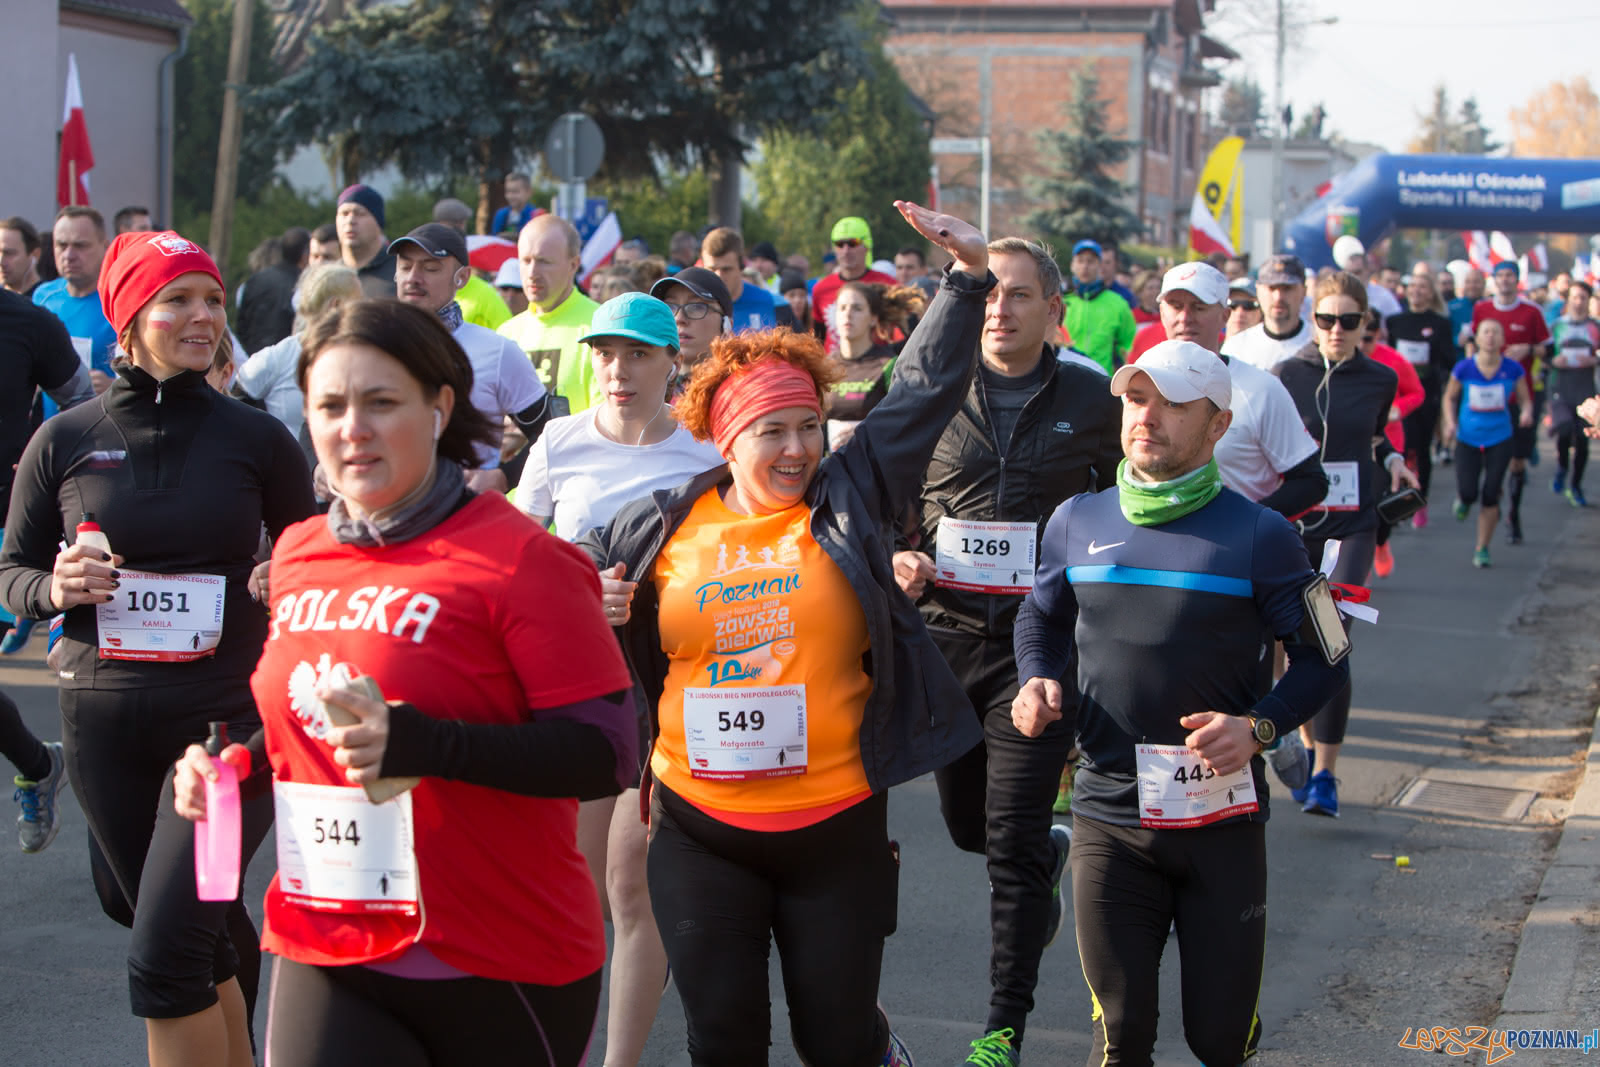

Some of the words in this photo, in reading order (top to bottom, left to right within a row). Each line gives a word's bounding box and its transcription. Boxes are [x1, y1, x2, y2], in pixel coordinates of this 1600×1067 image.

[961, 537, 1010, 556] 1269
[973, 561, 996, 569] Szymon
[144, 573, 160, 581] BIEG
[161, 574, 220, 585] NIEPODLEGŁOŚCI
[695, 568, 803, 613] Poznań
[127, 590, 190, 613] 1051
[214, 600, 222, 623] STREFA
[270, 584, 440, 643] POLSKA
[714, 606, 789, 637] zawsze
[142, 620, 172, 628] KAMILA
[740, 689, 799, 699] NIEPODLEGŁOŚCI
[718, 709, 765, 731] 549
[720, 739, 765, 749] Małgorzata
[1185, 788, 1210, 798] Marcin
[314, 817, 361, 846] 544
